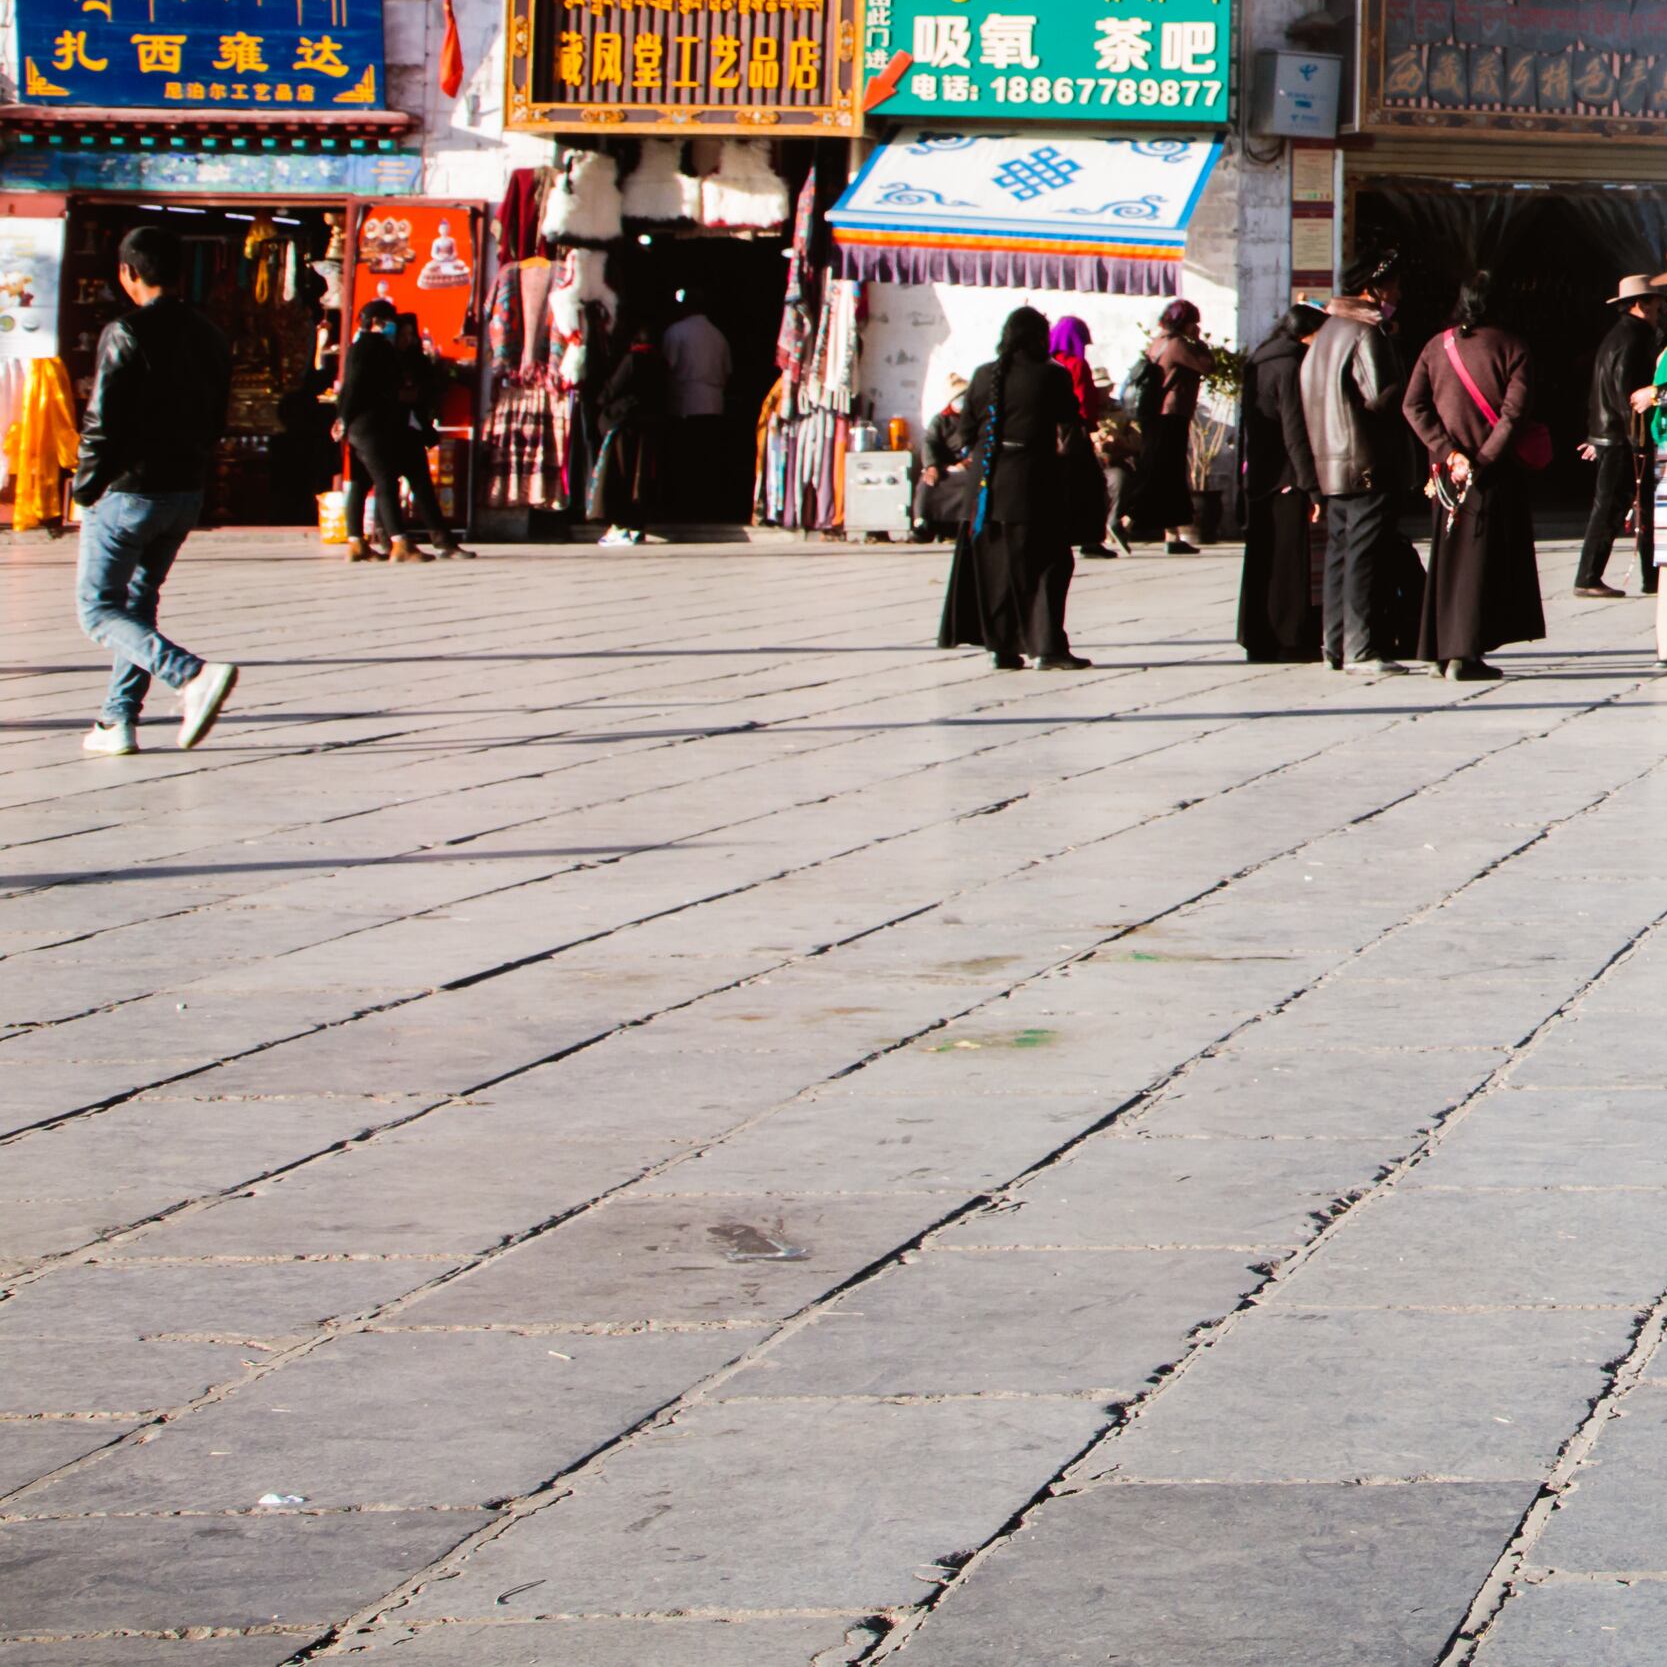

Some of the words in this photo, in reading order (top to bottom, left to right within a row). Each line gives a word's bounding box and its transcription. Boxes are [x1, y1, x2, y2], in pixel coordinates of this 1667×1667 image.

[51, 30, 349, 78] 扎西雍达
[556, 30, 820, 90] 藏凤堂工艺品店
[912, 14, 1040, 69] 吸氧
[1094, 18, 1217, 73] 茶吧
[990, 76, 1222, 107] 18867789877
